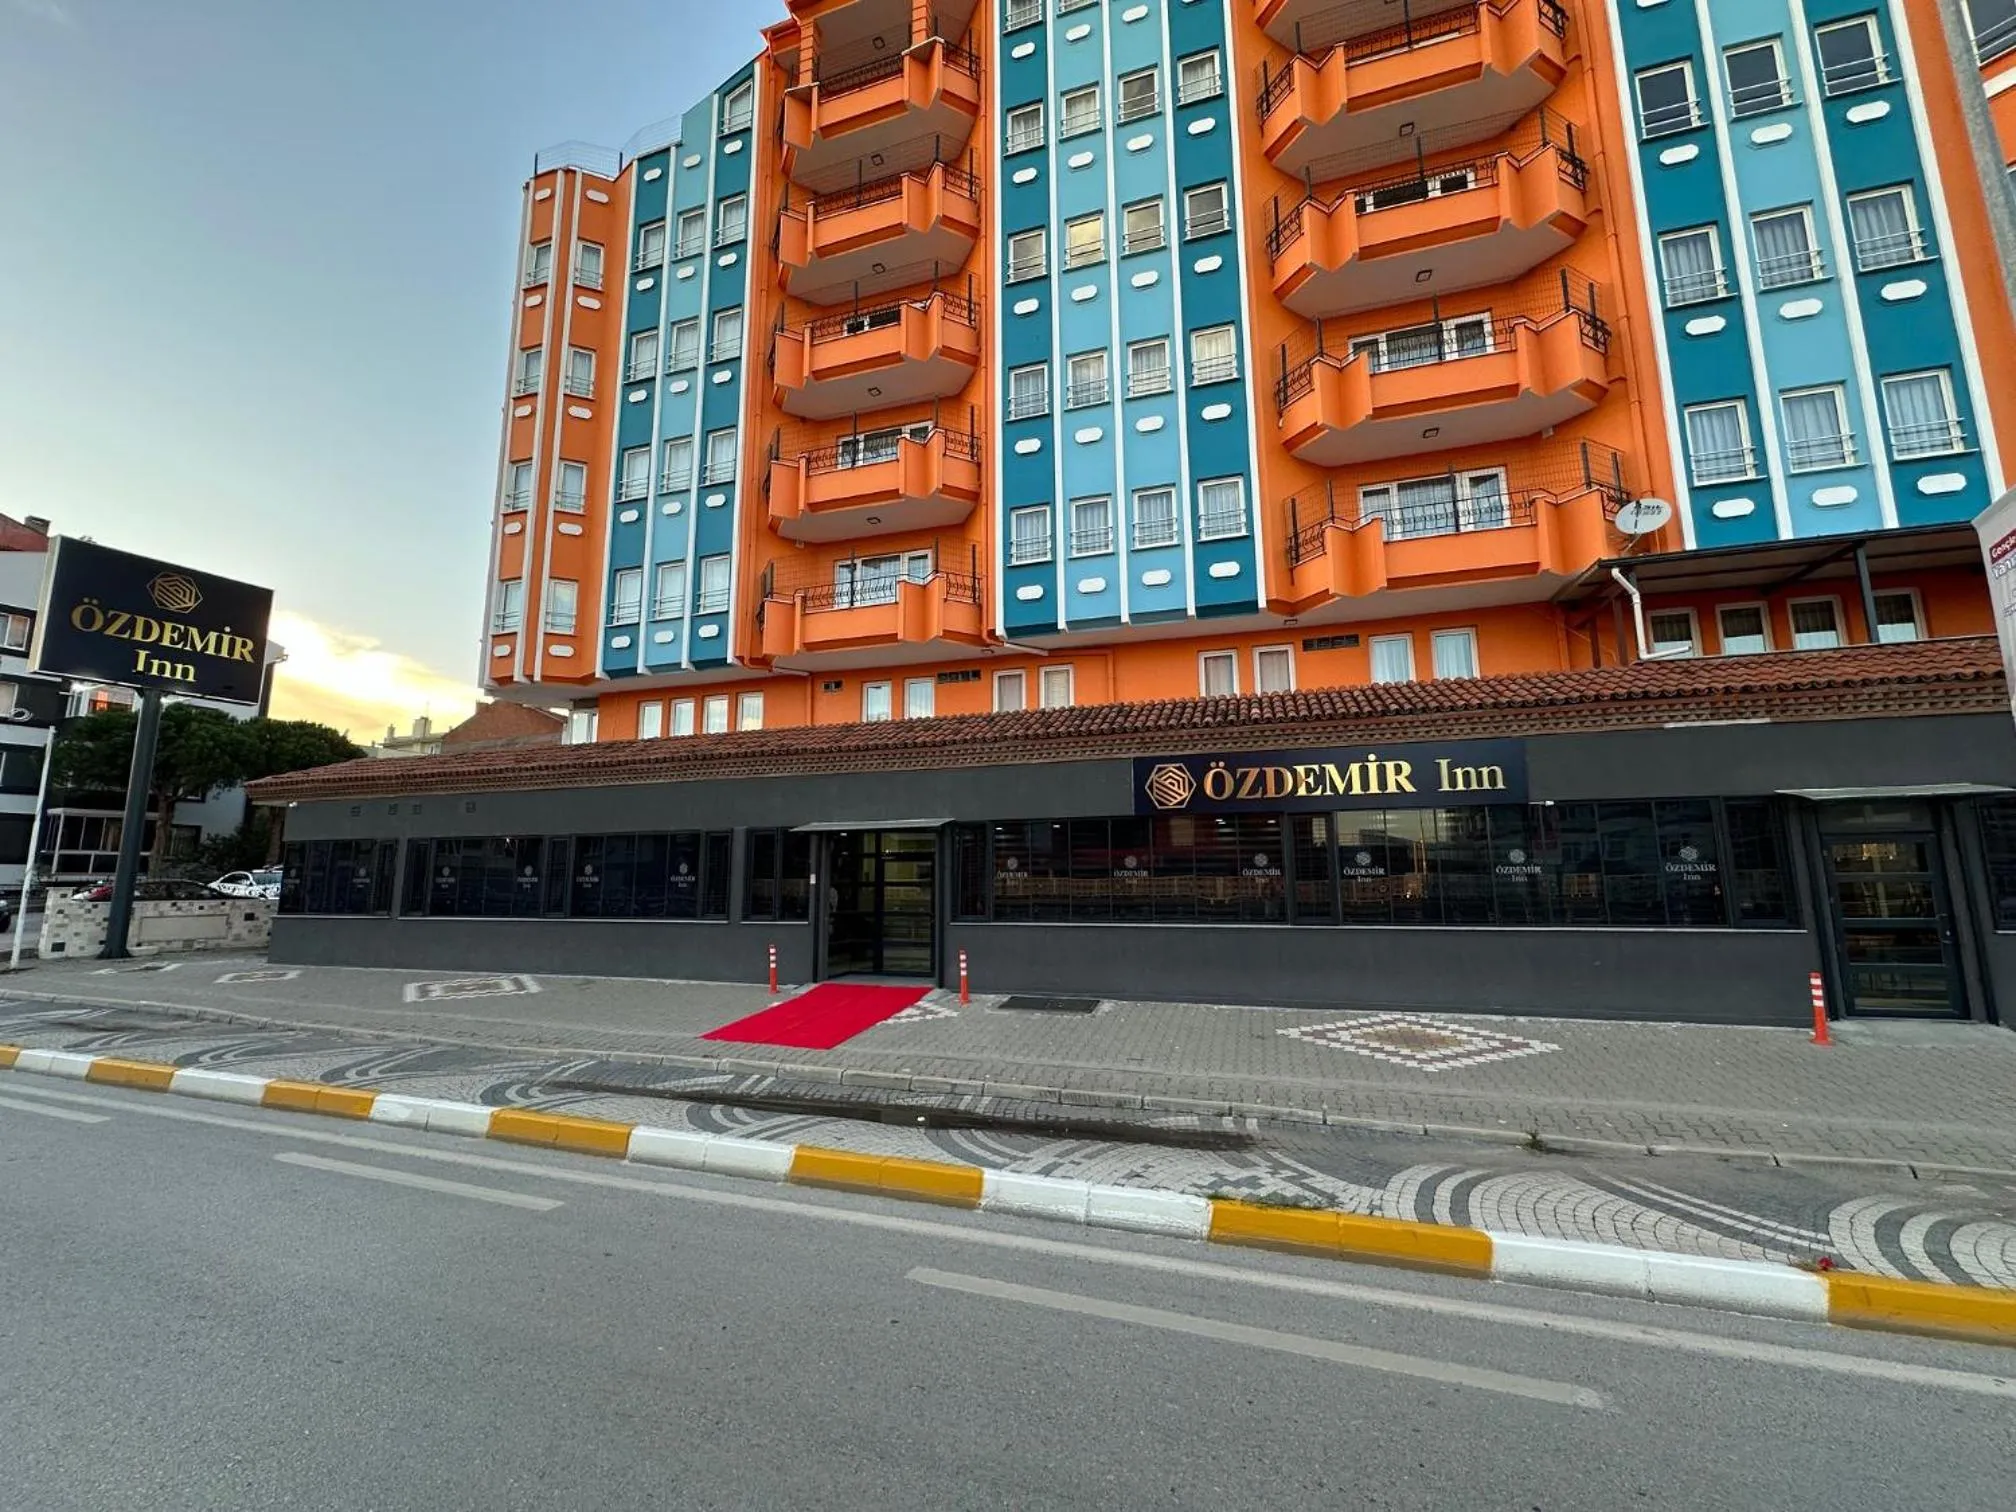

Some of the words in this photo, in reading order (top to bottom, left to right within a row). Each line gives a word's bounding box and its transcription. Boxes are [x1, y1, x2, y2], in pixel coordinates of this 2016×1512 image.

[71, 597, 254, 663] ÖZDEMİR
[132, 649, 196, 682] Inn
[1203, 753, 1417, 801] ÖZDEMİR
[1434, 758, 1506, 793] Inn
